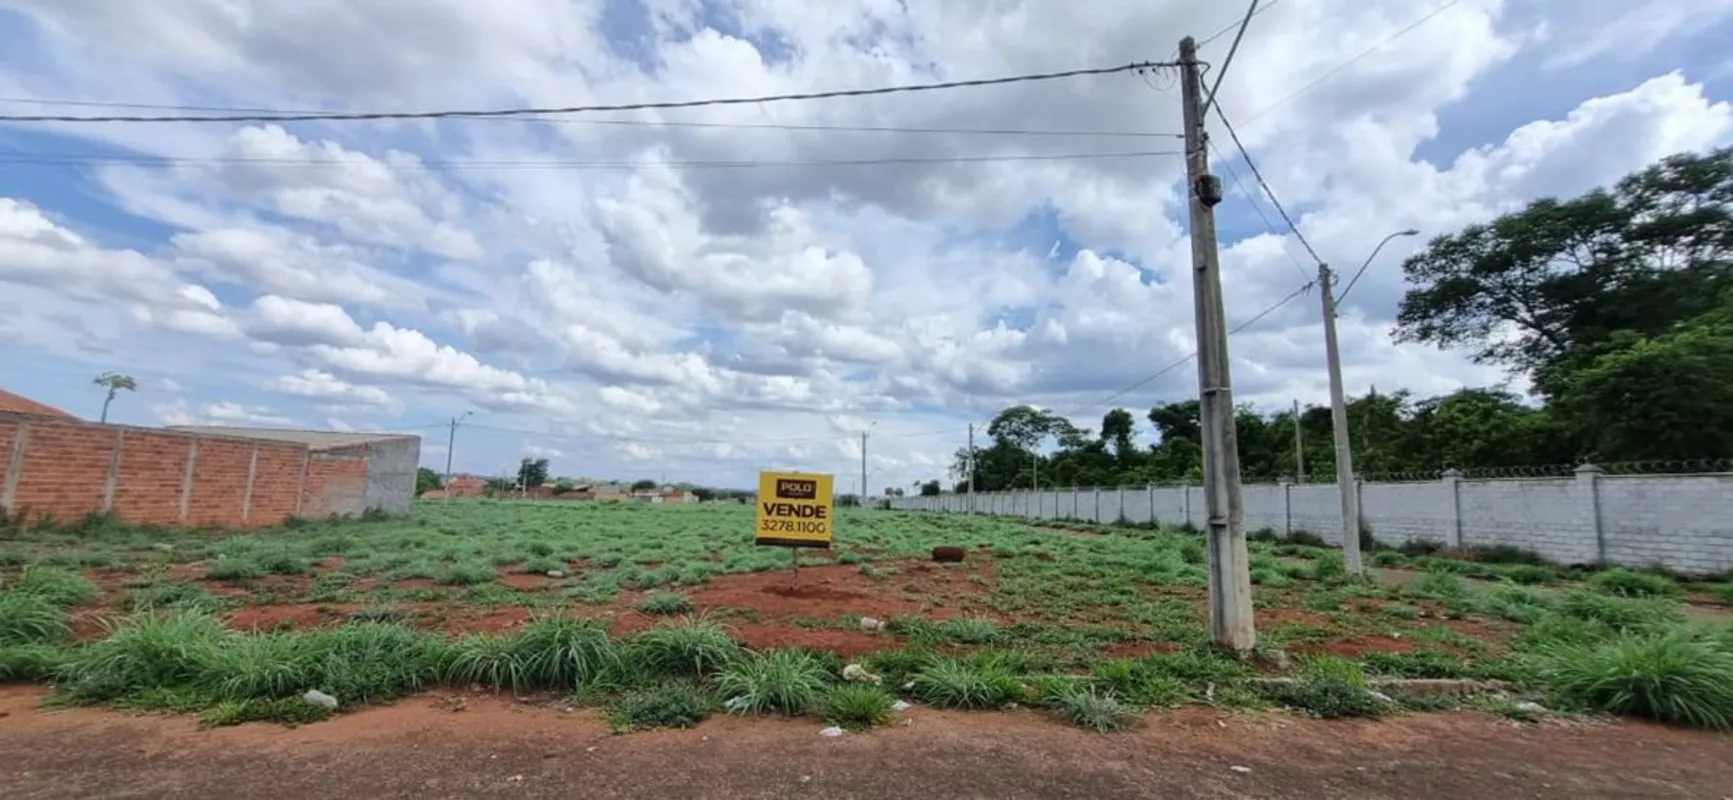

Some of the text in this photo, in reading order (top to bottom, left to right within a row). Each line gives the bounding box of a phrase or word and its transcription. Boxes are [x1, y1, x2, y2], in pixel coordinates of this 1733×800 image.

[781, 482, 812, 492] POLO
[763, 502, 827, 519] VENDE
[761, 519, 826, 534] 3278.1100
